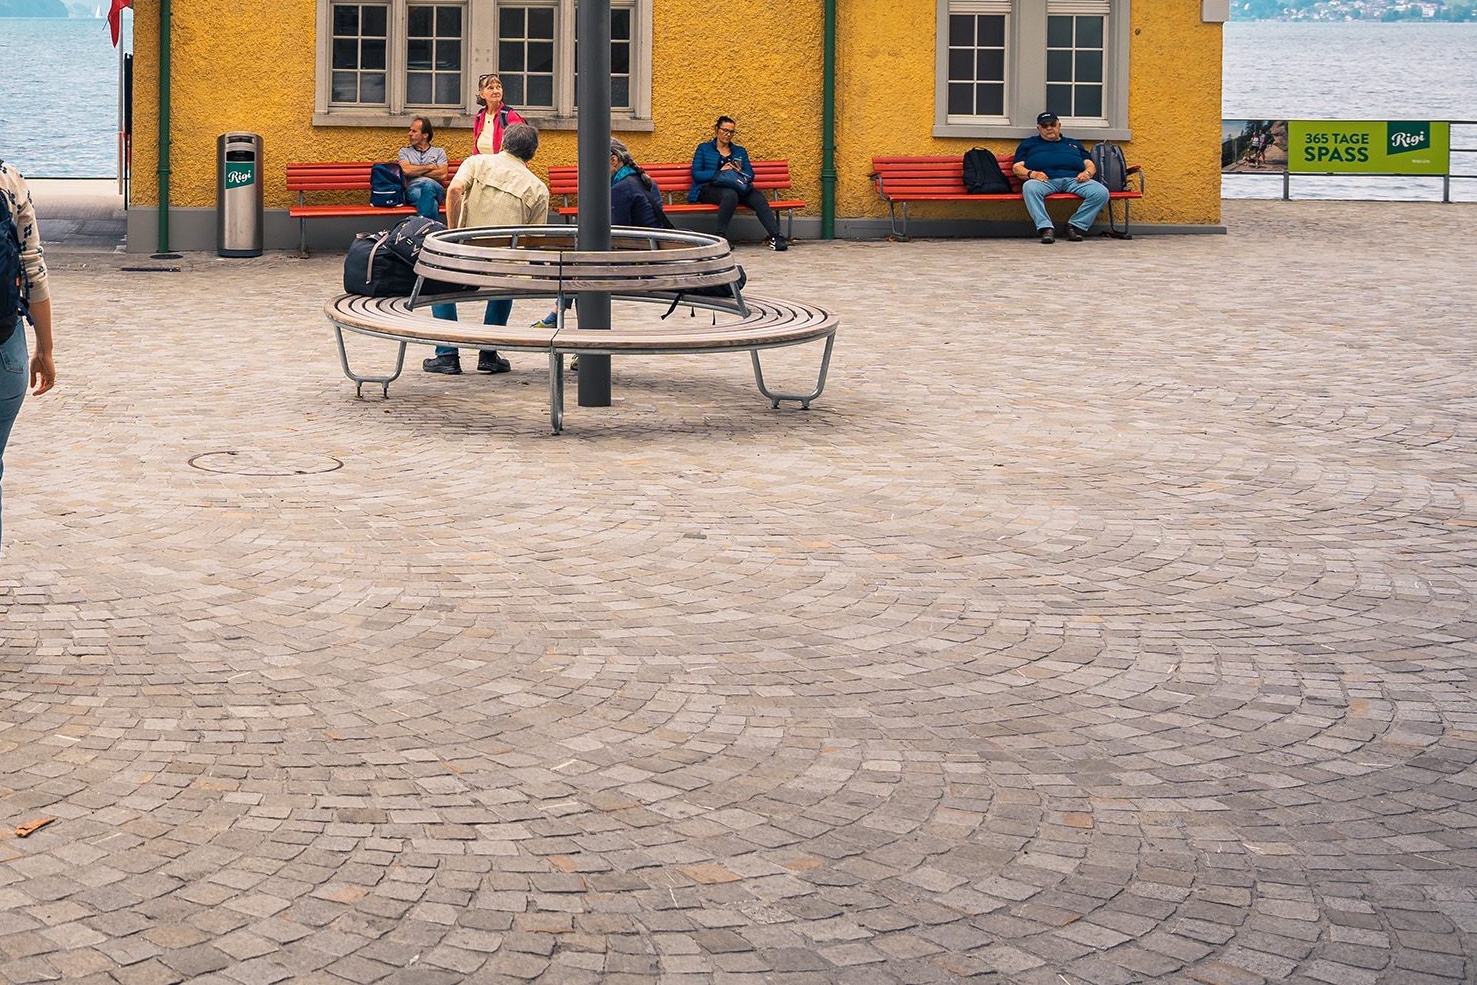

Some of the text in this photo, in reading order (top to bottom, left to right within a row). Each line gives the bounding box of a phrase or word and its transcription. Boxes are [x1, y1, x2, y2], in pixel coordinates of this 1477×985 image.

[1305, 133, 1369, 144] 365 TAGE
[1391, 130, 1425, 148] Rigi
[1304, 146, 1369, 162] SPASS
[228, 170, 252, 183] Rigi
